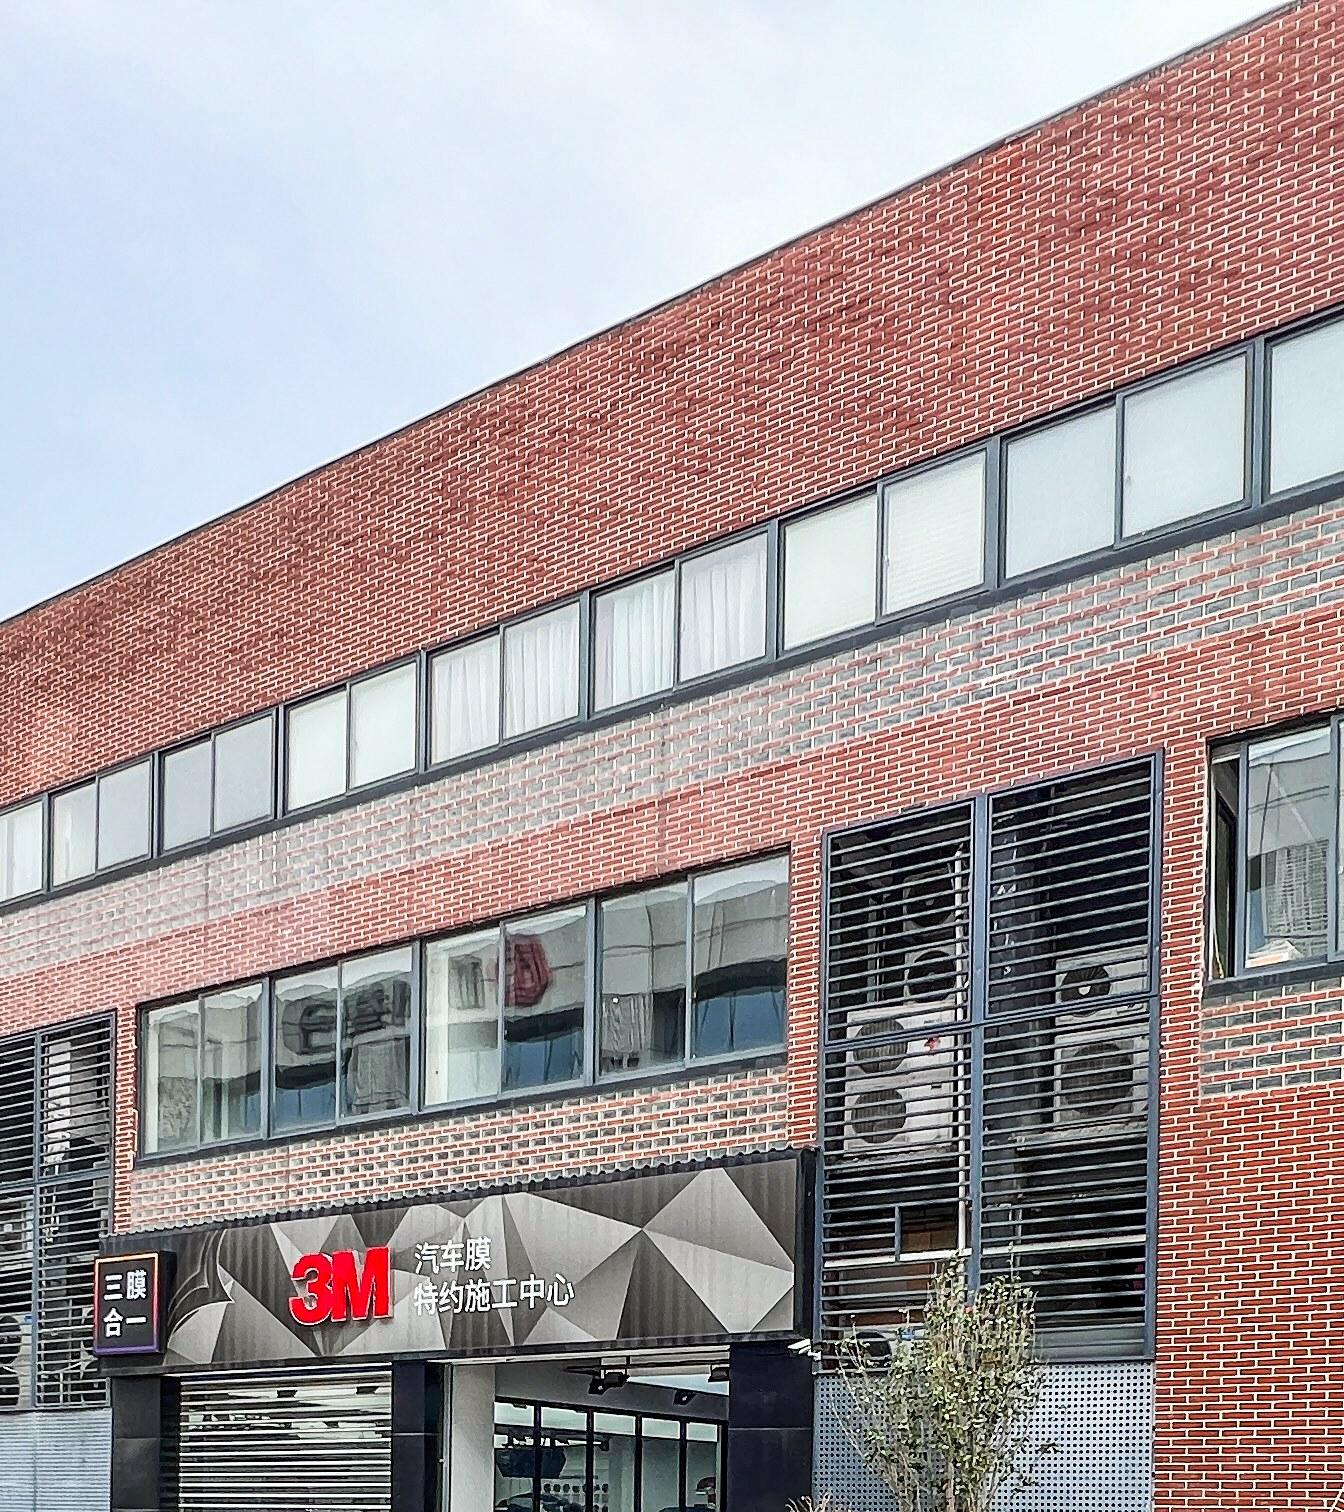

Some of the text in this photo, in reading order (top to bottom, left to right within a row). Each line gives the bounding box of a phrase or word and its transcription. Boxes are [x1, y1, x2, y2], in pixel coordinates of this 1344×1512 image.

[413, 1237, 493, 1275] 汽车膜
[102, 1269, 148, 1301] 三膜
[288, 1246, 395, 1327] 3M
[413, 1273, 576, 1317] 特约施工中心
[102, 1306, 148, 1340] 合一
